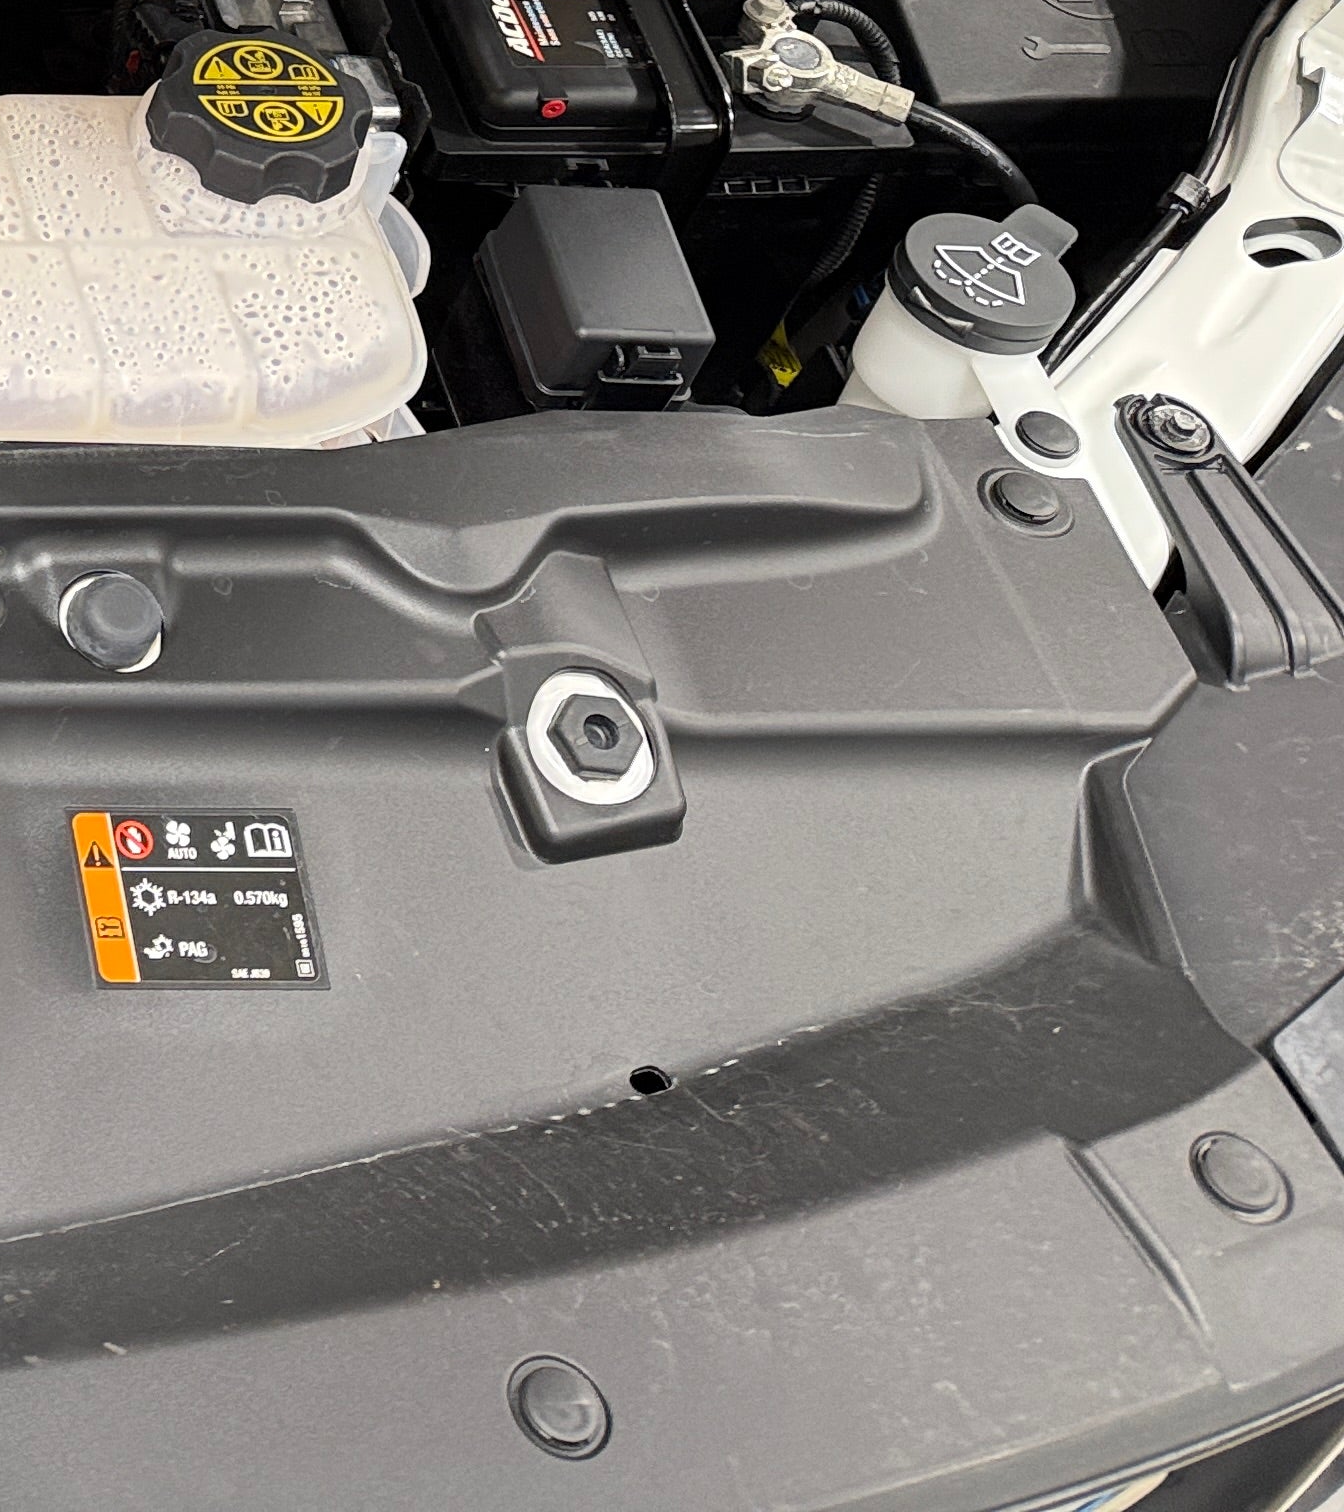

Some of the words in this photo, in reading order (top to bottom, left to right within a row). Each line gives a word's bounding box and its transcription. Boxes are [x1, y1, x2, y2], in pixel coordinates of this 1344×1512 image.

[167, 847, 198, 861] AUTO
[166, 890, 218, 906] R-134a
[233, 890, 289, 909] 0.570kg
[178, 941, 209, 958] PAG
